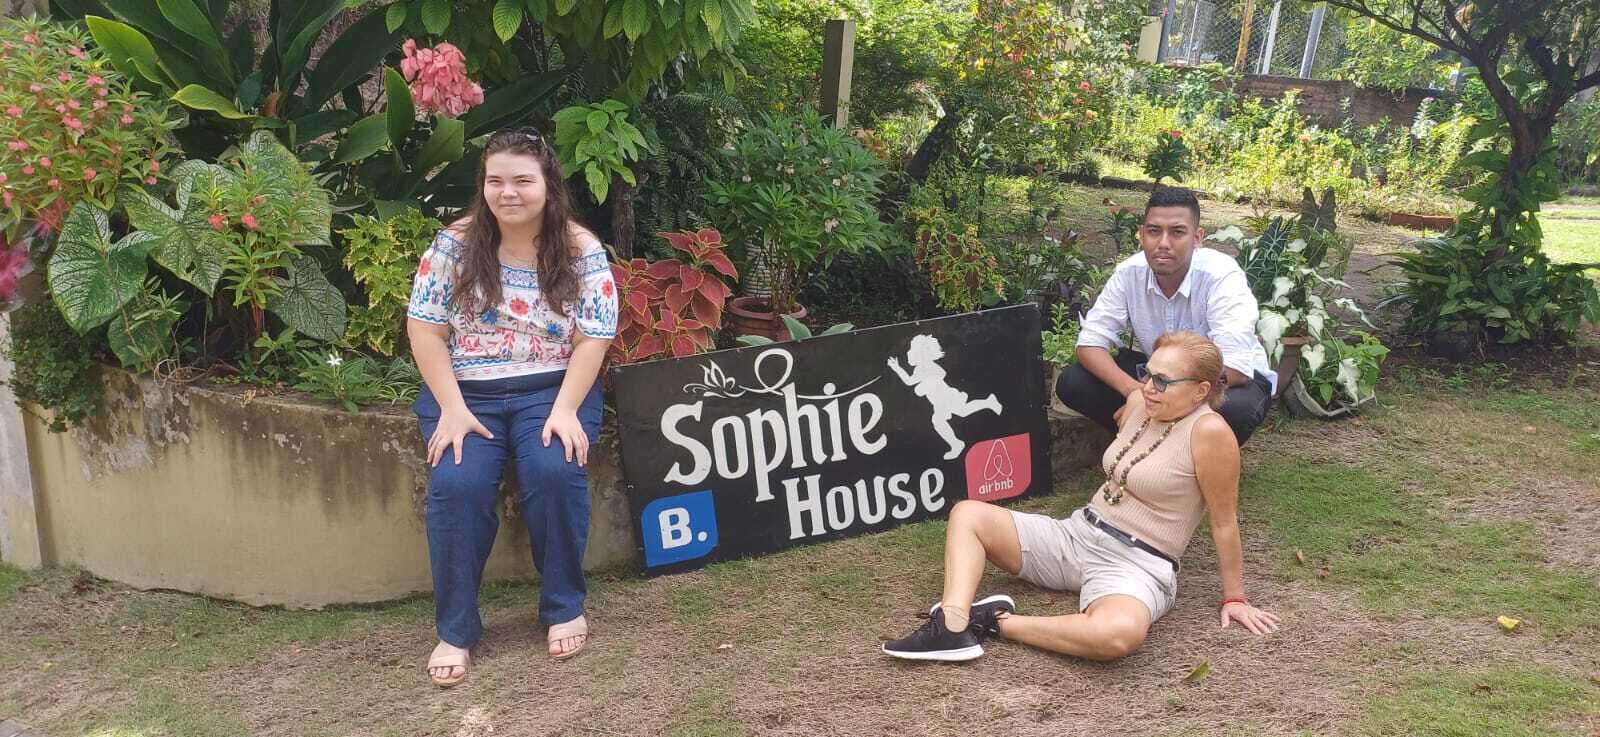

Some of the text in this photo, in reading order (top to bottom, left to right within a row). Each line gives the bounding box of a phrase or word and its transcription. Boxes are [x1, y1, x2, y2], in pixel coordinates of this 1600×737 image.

[660, 381, 888, 503] Sophie
[781, 467, 946, 541] House
[978, 477, 1014, 495] airbnb
[658, 507, 708, 550] B.
